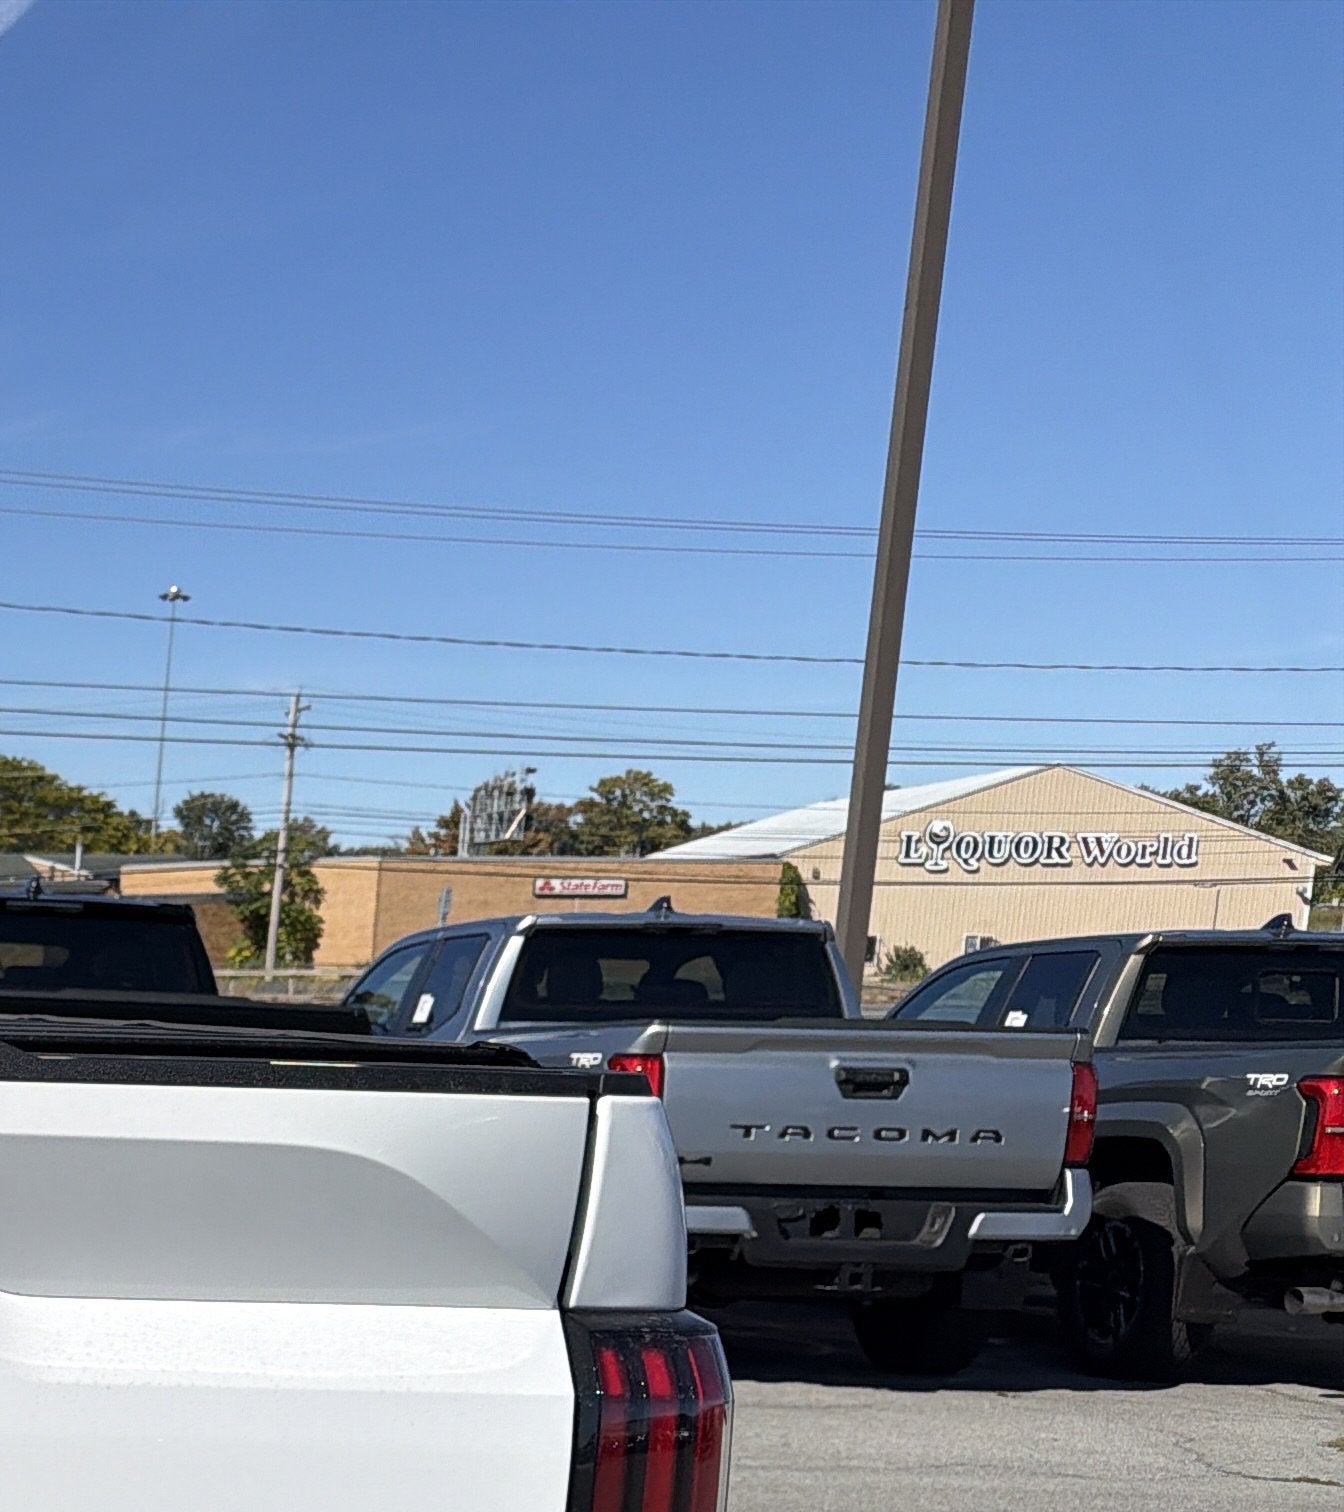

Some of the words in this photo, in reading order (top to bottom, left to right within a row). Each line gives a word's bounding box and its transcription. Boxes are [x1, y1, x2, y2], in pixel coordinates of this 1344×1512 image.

[1077, 832, 1198, 865] World
[569, 1052, 603, 1069] TRD
[1246, 1073, 1289, 1088] TRD
[730, 1123, 1006, 1145] TACOMA
